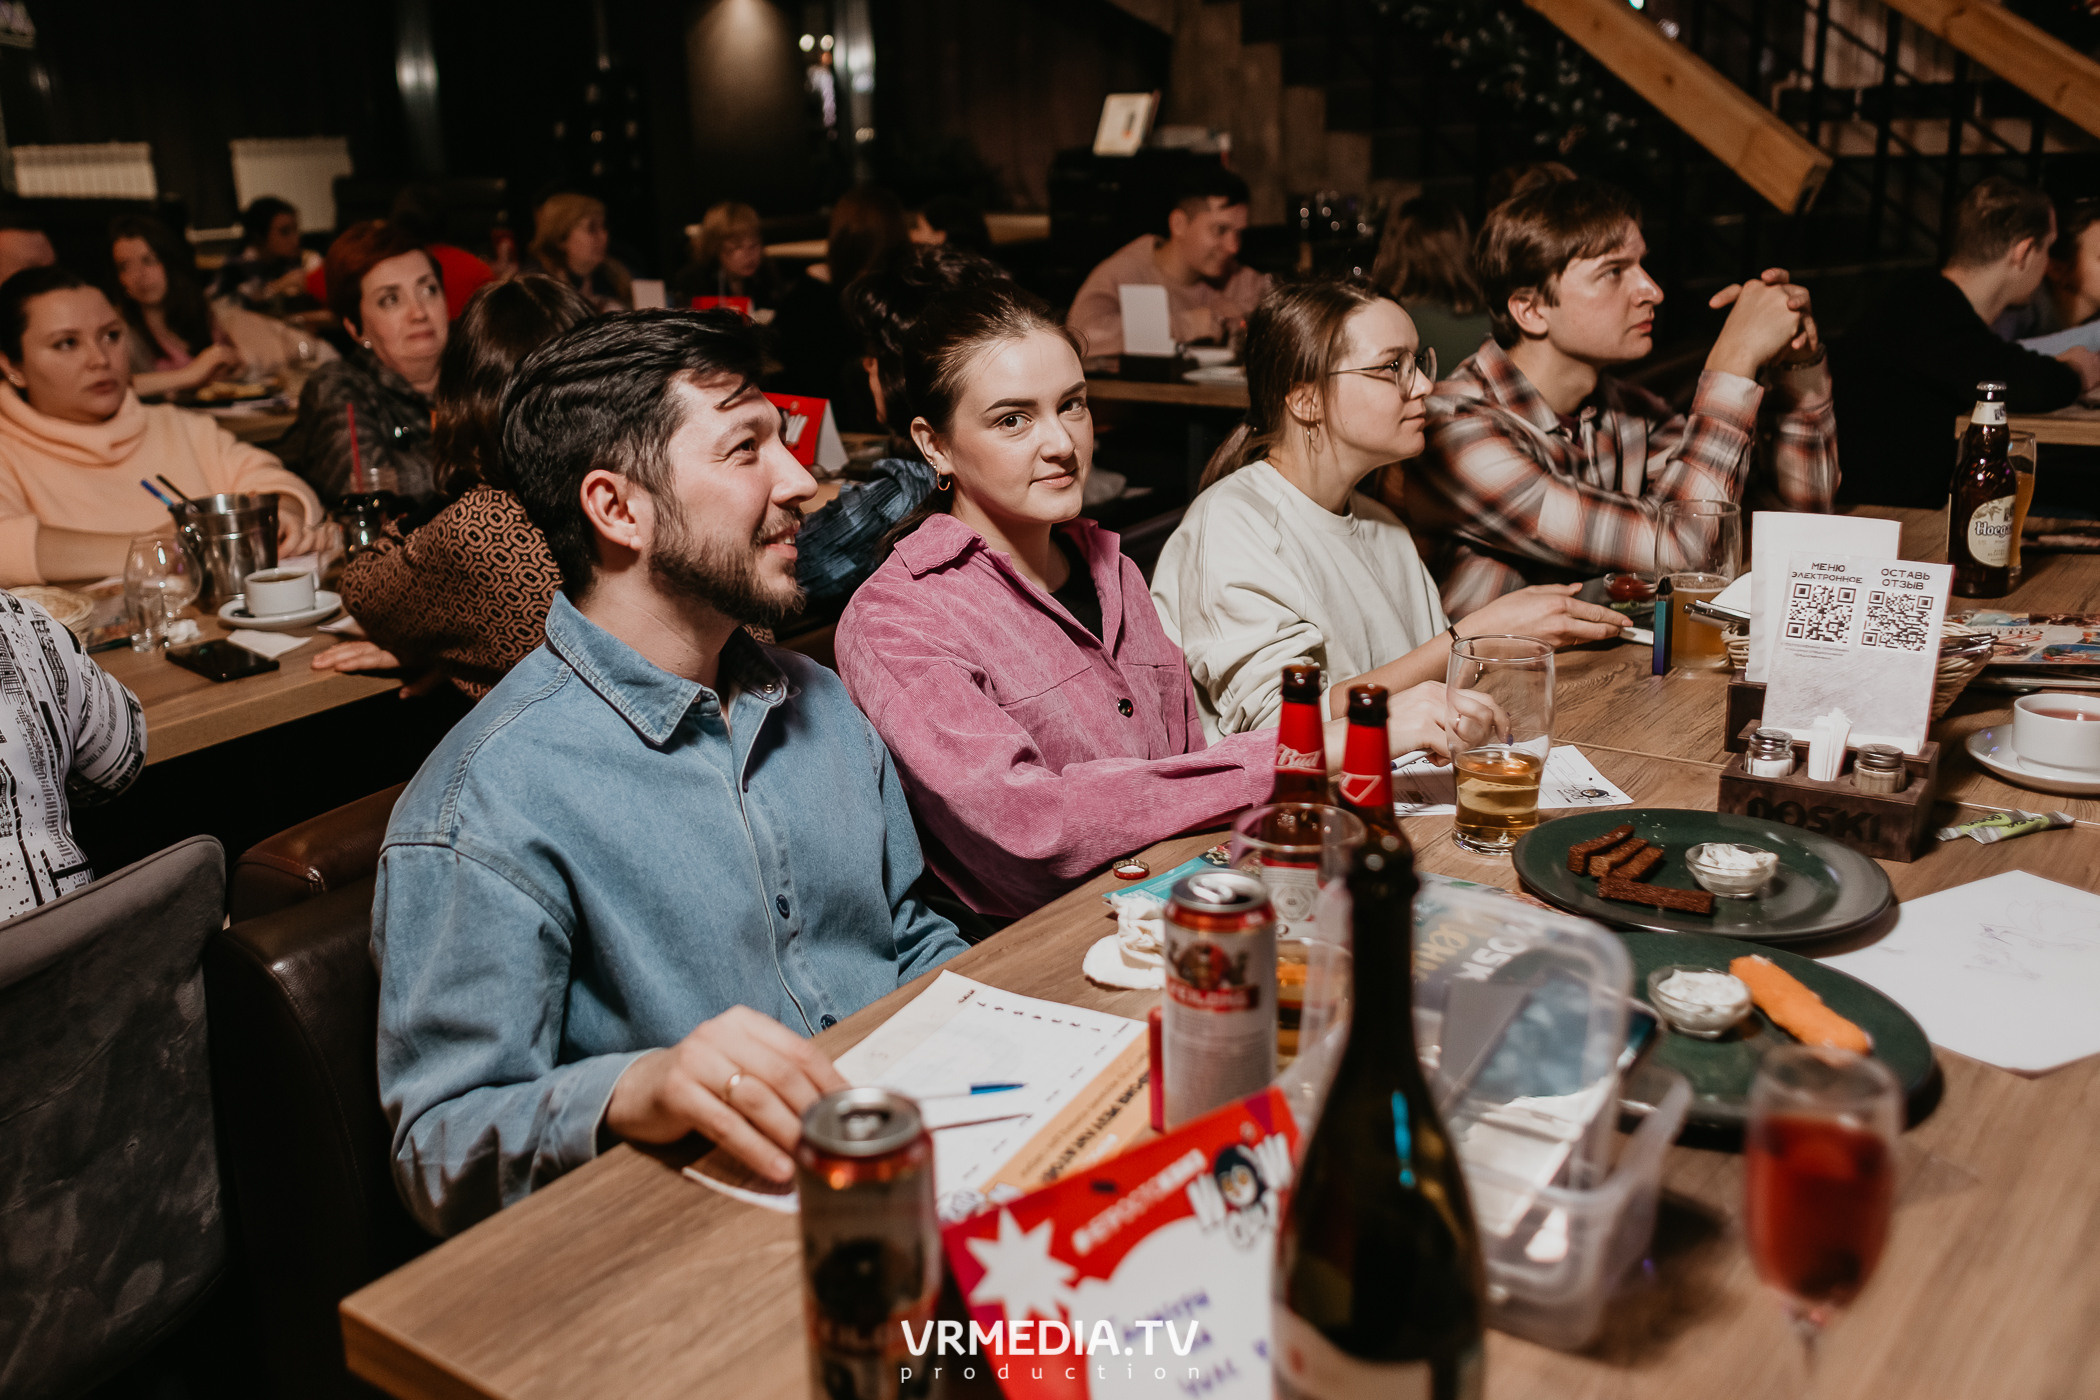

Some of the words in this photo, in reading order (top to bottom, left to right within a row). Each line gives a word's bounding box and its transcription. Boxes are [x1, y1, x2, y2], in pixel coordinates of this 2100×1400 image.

[1811, 562, 1846, 573] МЕНЮ
[1791, 571, 1863, 584] ЭЛЕКТРОННОЕ
[1881, 568, 1931, 581] ОСТАВЬ
[1882, 578, 1924, 590] ОТЗЫВ
[1278, 747, 1320, 768] Bud
